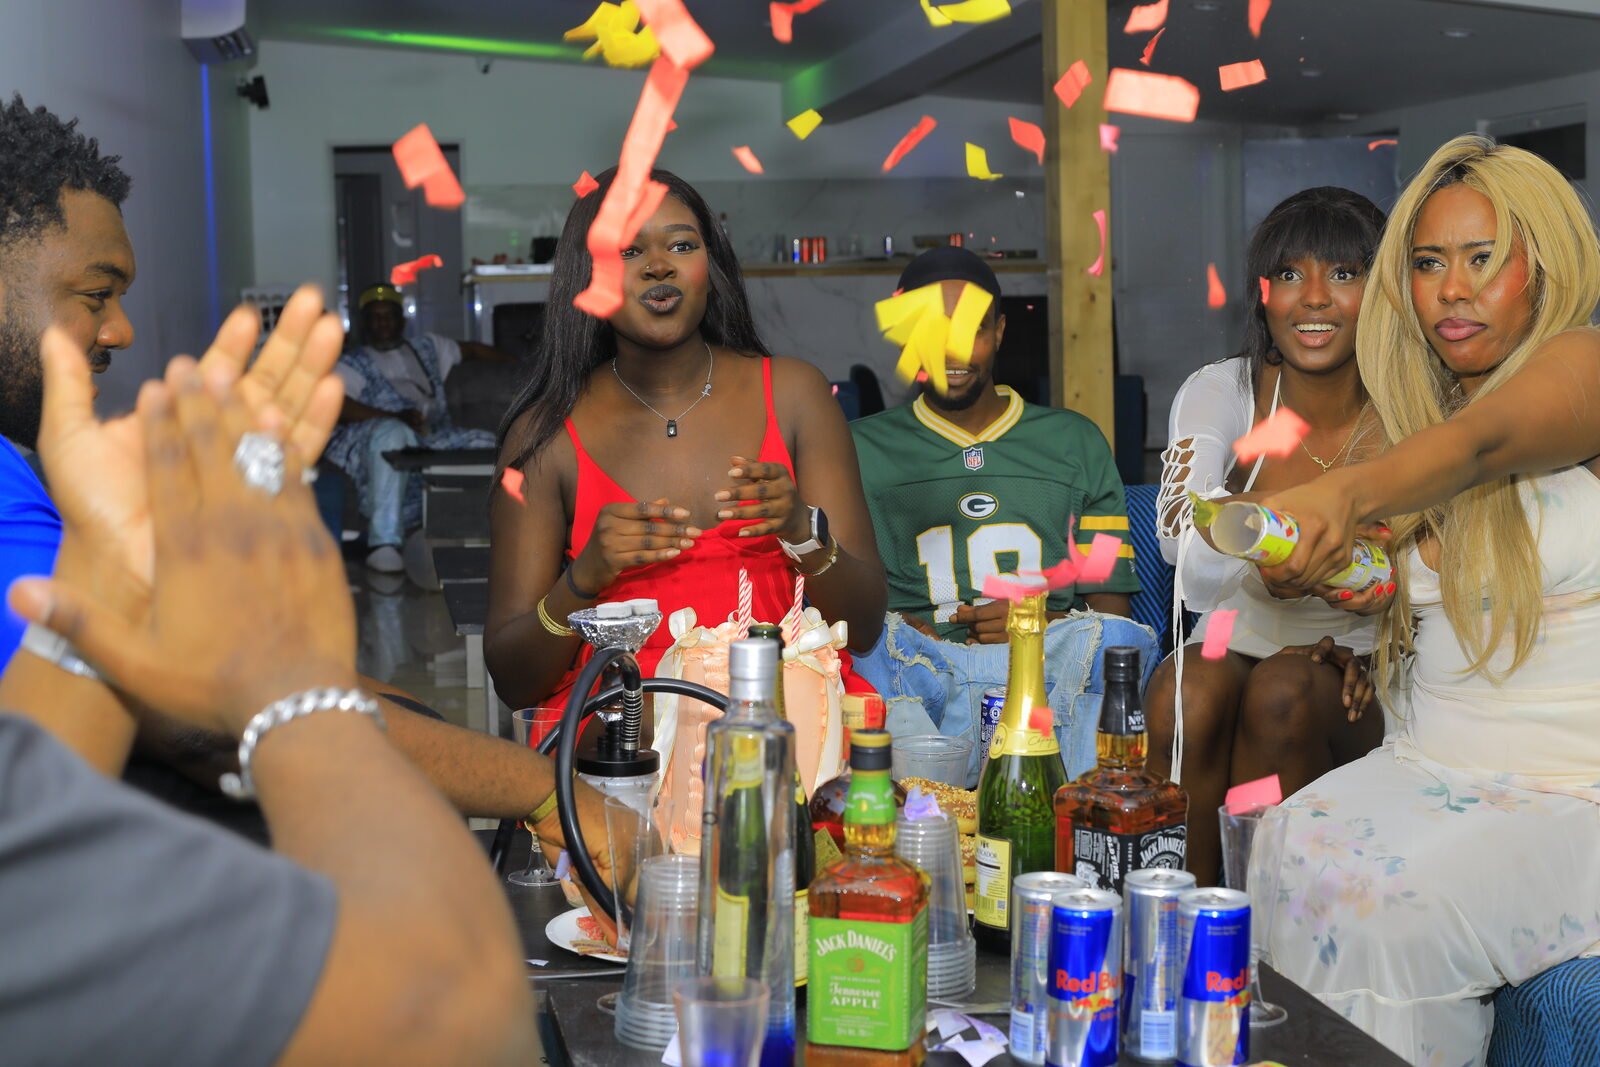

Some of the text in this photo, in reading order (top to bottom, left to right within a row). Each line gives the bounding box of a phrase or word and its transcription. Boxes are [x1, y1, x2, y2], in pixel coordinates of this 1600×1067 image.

[968, 457, 980, 466] NFL
[958, 492, 999, 519] G
[1106, 836, 1120, 880] OLD TIME
[1140, 835, 1187, 868] JACK DANIEL'S
[815, 930, 897, 962] JACK DANIEL'S
[829, 982, 881, 999] Tennessee
[1056, 968, 1097, 993] Red
[1206, 968, 1245, 993] Red
[831, 996, 881, 1010] APPLE
